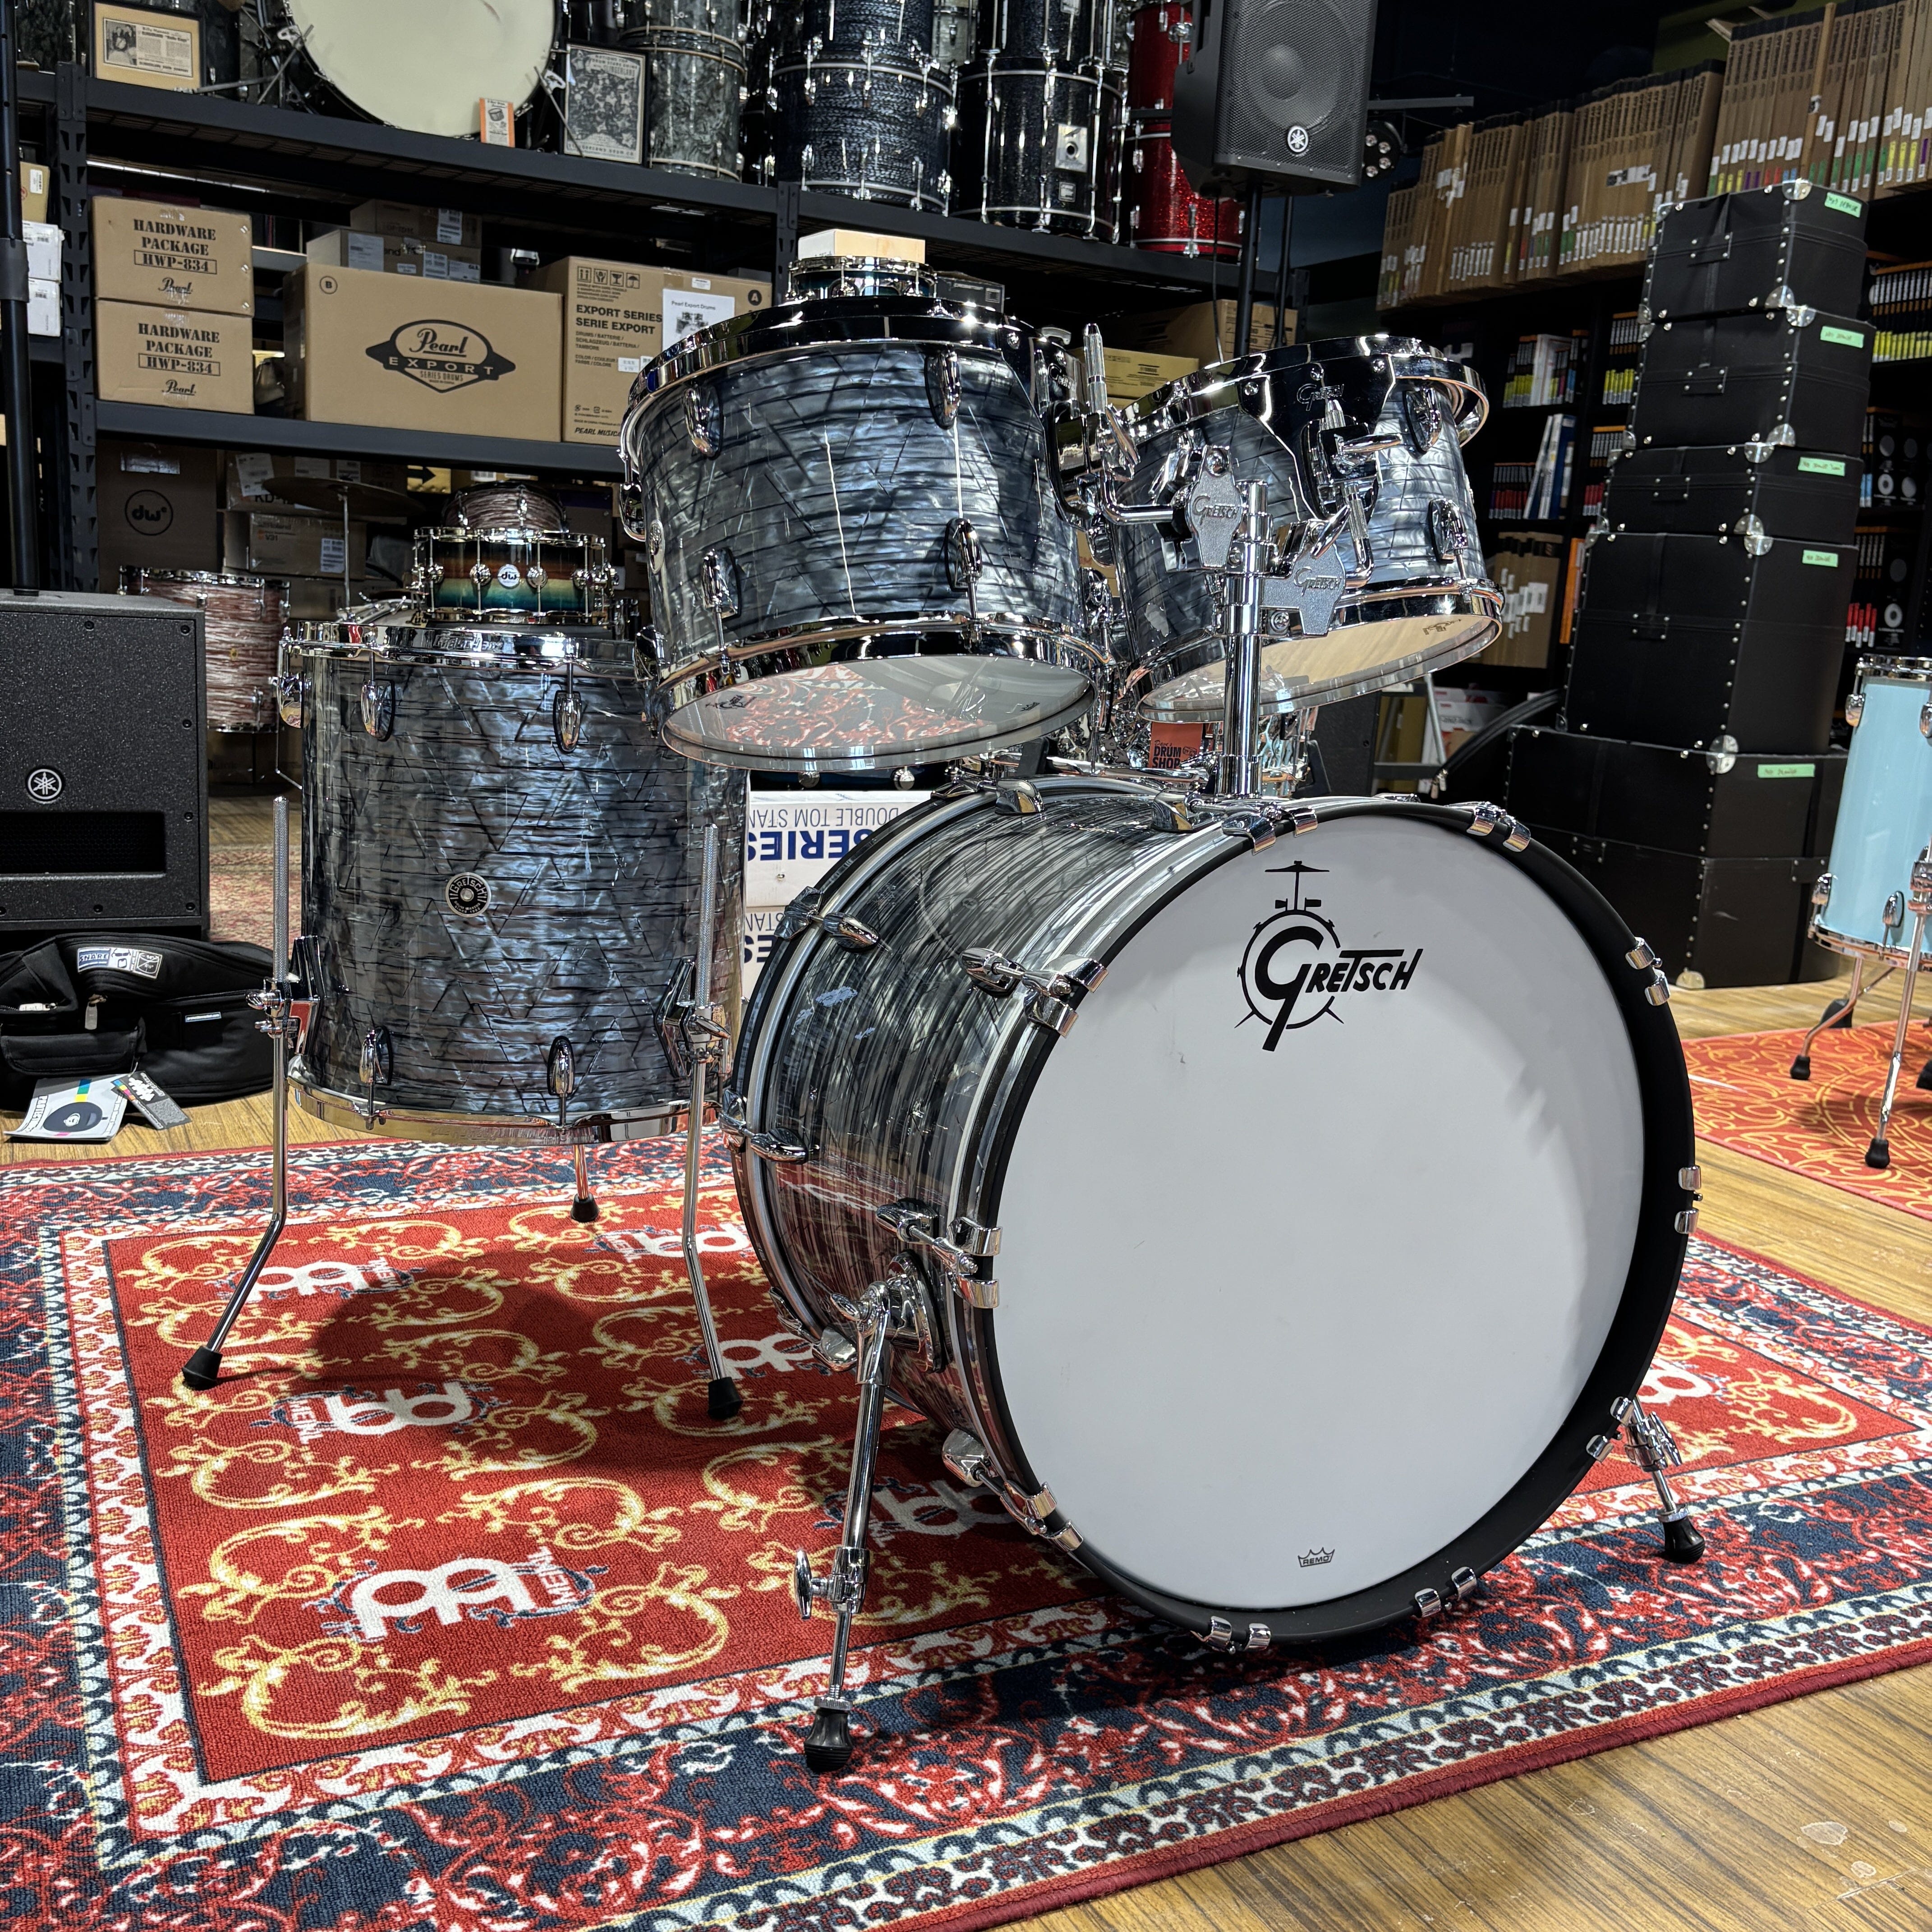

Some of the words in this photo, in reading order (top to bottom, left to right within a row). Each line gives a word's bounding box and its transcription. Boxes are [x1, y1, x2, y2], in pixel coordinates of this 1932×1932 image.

[133, 219, 216, 240] HARDWARE
[142, 237, 209, 256] PACKAGE
[143, 253, 208, 272] HWP-834
[158, 277, 193, 294] Pearl
[751, 293, 759, 302] A
[577, 304, 621, 317] EXPORT
[623, 310, 662, 323] SERIES
[138, 323, 220, 343] HARDWARE
[576, 317, 608, 329] SERIE
[612, 322, 656, 335] EXPORT
[146, 340, 212, 358] PACKAGE
[409, 328, 469, 357] Pearl
[147, 356, 212, 374] HWP-834
[389, 357, 493, 375] EXPORT
[420, 370, 441, 380] SERIES
[442, 373, 464, 382] DRUMS
[162, 379, 196, 396] Pearl
[501, 571, 517, 580] dw
[1154, 746, 1182, 758] DRUM
[1152, 757, 1181, 769] SHOP
[795, 809, 830, 827] TOM
[836, 808, 899, 827] DOUBLE
[449, 875, 488, 895] GRETSCH
[1302, 1556, 1330, 1565] REMO
[526, 1545, 579, 1605] MEINL
